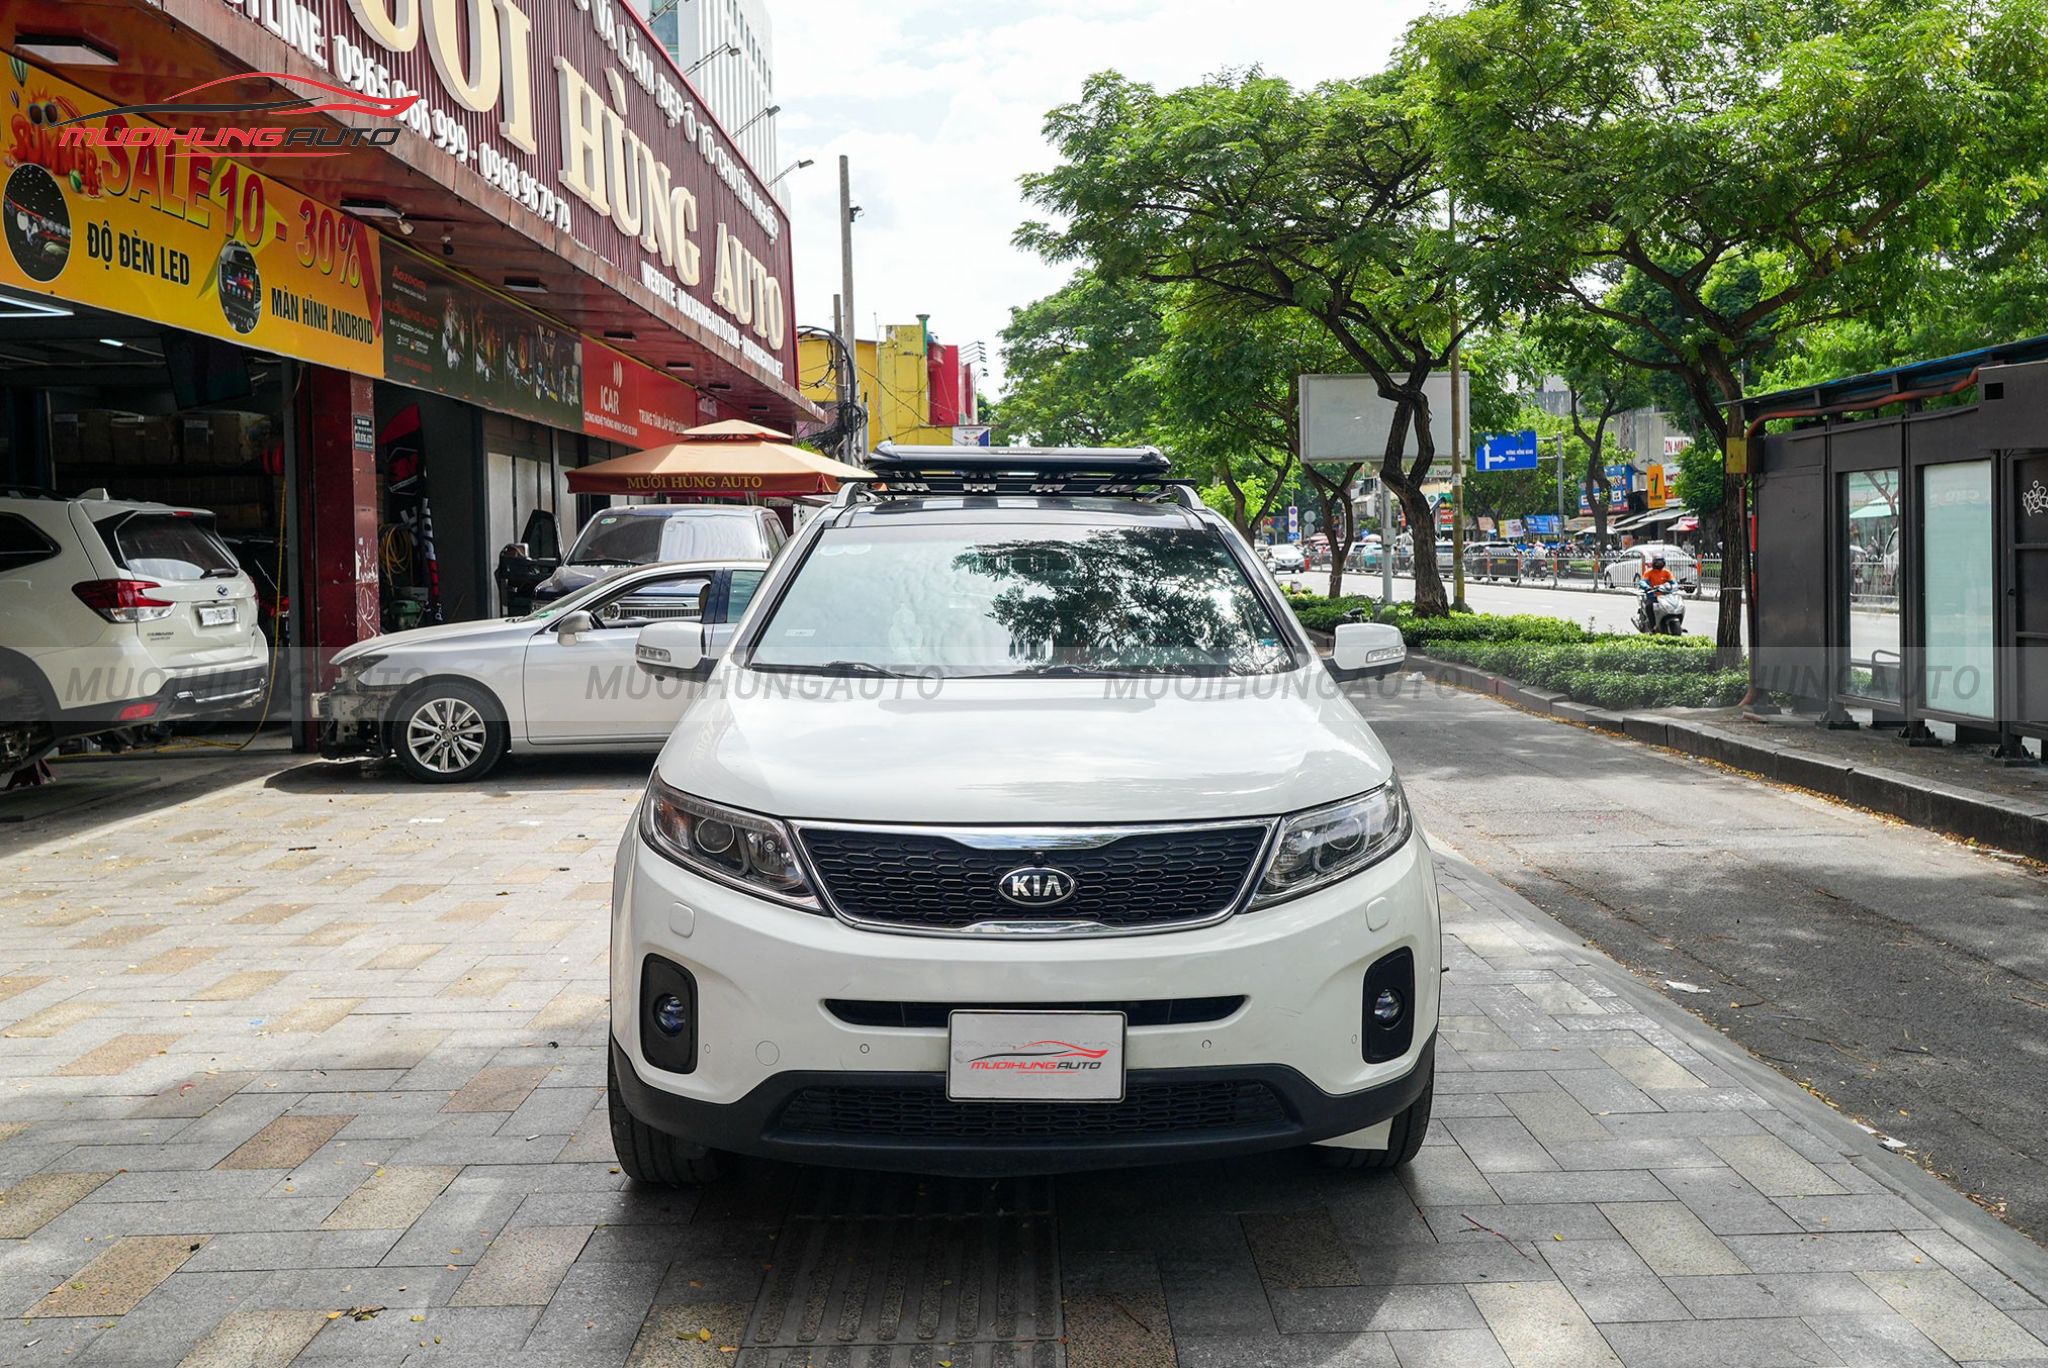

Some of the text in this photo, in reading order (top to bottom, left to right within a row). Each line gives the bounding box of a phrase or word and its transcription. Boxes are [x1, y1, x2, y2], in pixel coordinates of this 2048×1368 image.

[431, 108, 469, 163] 999
[616, 24, 655, 95] LÀM
[655, 72, 685, 129] ĐẸP
[684, 101, 698, 142] Ô
[697, 121, 716, 165] TÔ
[714, 146, 752, 212] CHUYÊN
[100, 114, 212, 230] SALE
[219, 164, 266, 248] 10
[553, 55, 701, 287] HÙNG
[711, 222, 785, 351] AUTO
[87, 220, 191, 287] ĐỘ ĐÈN LED
[271, 286, 300, 324] MÀN
[301, 295, 329, 333] HÌNH
[331, 314, 374, 346] ANDROID
[600, 384, 620, 415] ICAR
[627, 473, 763, 489] MƯỜI HÙNG AUTO
[1011, 875, 1064, 897] KIA
